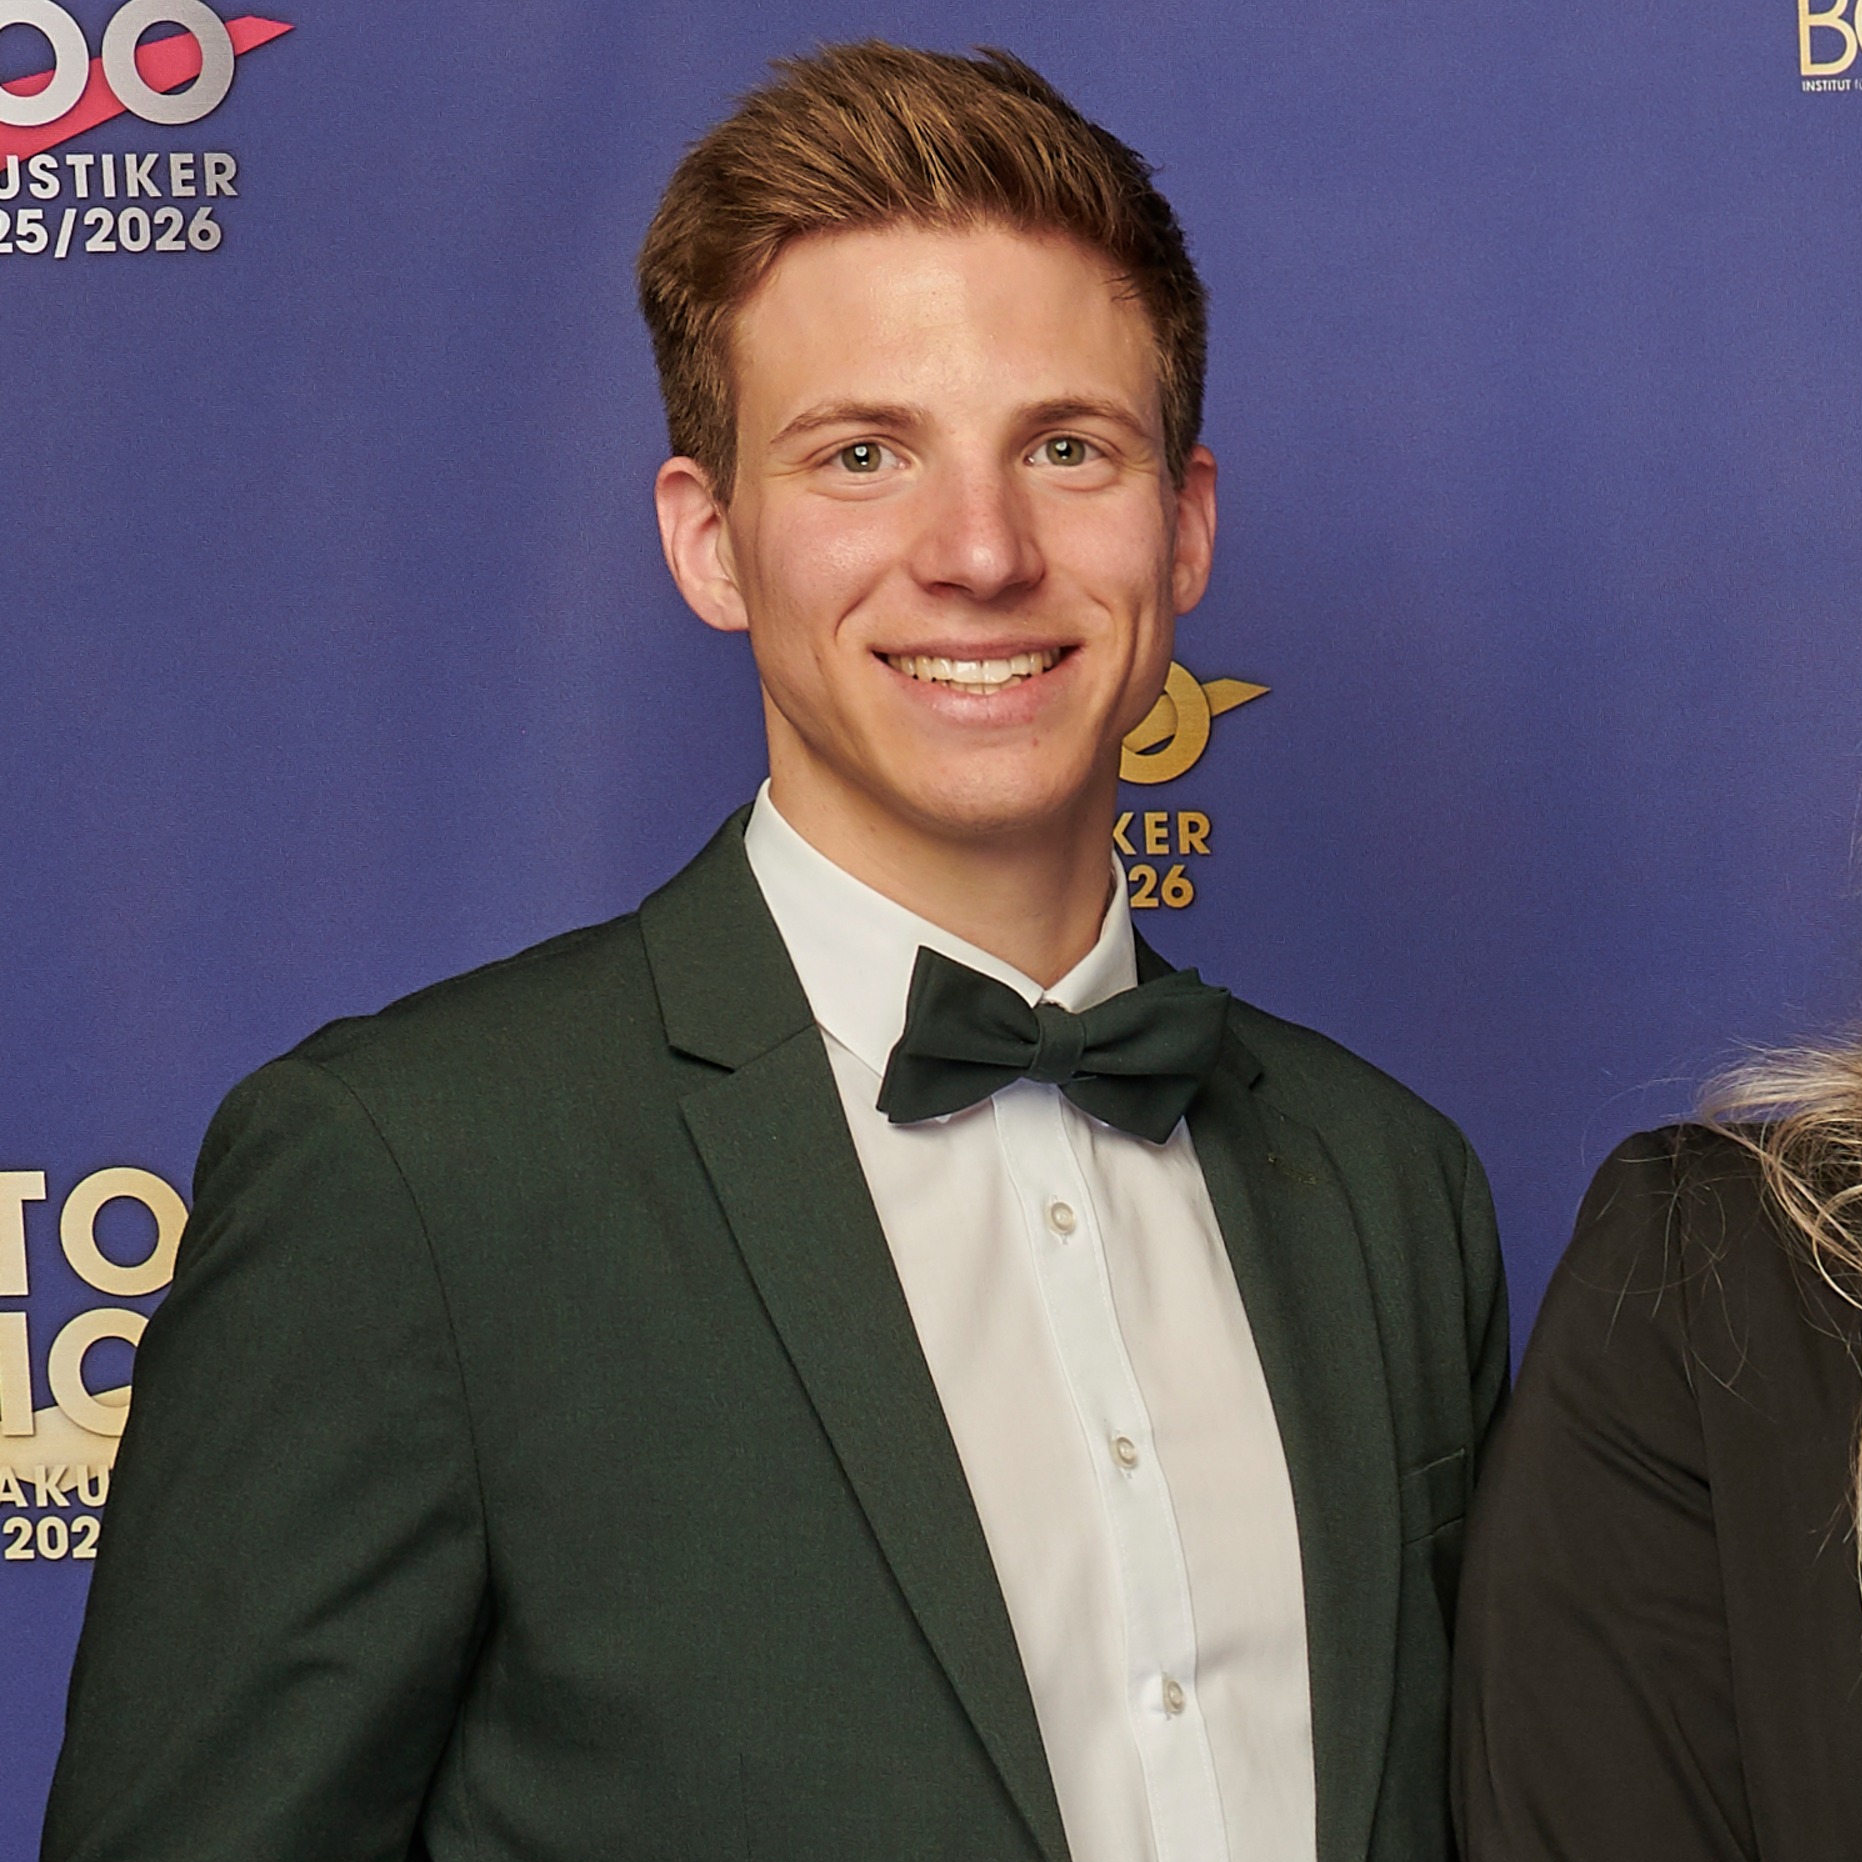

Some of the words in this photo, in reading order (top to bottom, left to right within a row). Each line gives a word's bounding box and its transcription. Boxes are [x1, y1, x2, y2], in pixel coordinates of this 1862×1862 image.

[0, 0, 235, 126] 00
[1802, 80, 1851, 92] INSTITUT
[0, 153, 239, 199] USTIKER
[0, 1167, 189, 1296] TO
